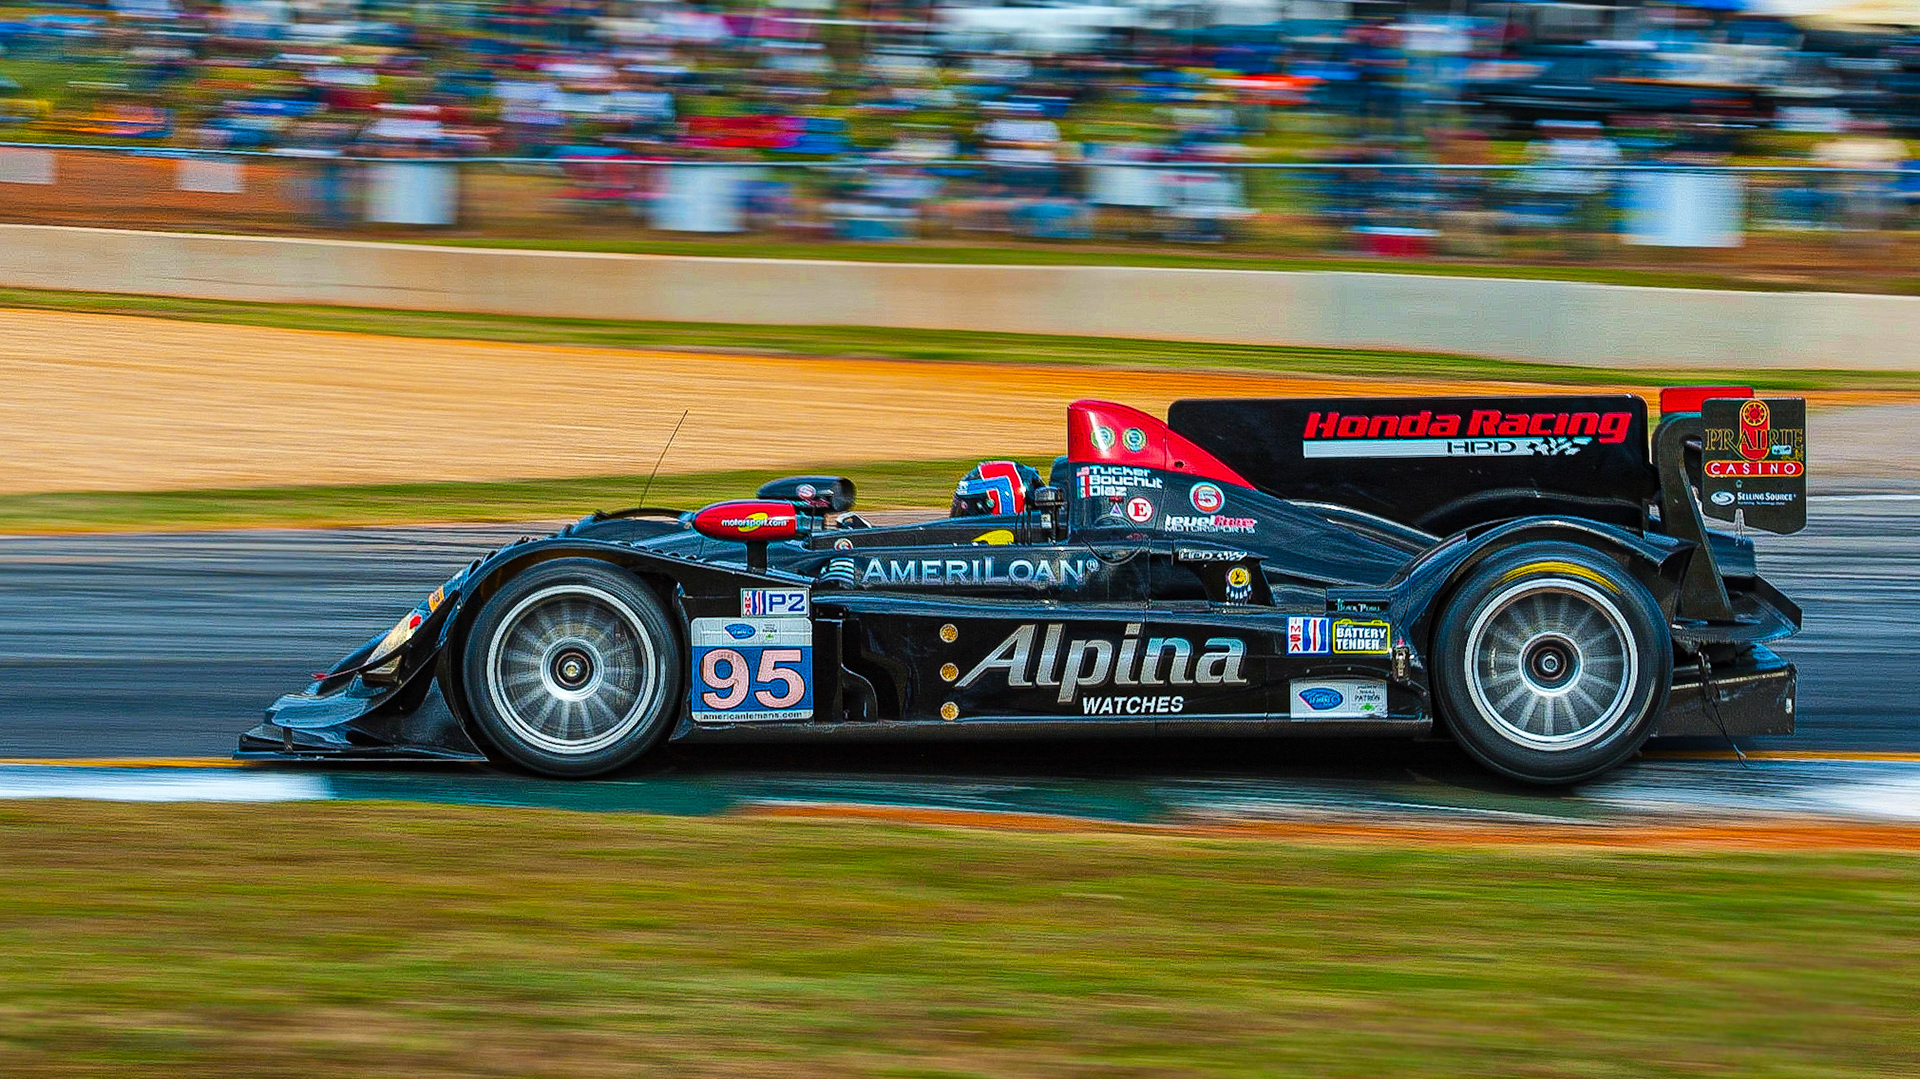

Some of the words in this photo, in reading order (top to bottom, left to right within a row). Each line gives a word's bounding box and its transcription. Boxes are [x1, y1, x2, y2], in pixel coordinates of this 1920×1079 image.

[1303, 411, 1461, 438] Honda
[1467, 410, 1632, 443] Racing
[1447, 440, 1518, 454] HPD
[1705, 428, 1803, 453] PRAIRIE
[1089, 465, 1152, 477] Tucker
[1710, 463, 1796, 475] CASINO
[1089, 475, 1163, 489] Bouchut
[1089, 485, 1127, 496] Diaz
[1197, 490, 1220, 508] 5
[1133, 502, 1148, 517] E
[721, 517, 789, 528] motorsport.com
[768, 594, 805, 612] P2
[1336, 627, 1387, 639] BATTERY
[1336, 638, 1380, 650] TENDER
[954, 623, 1248, 703] Alpina
[701, 648, 806, 710] 95
[1083, 696, 1184, 714] WATCHES
